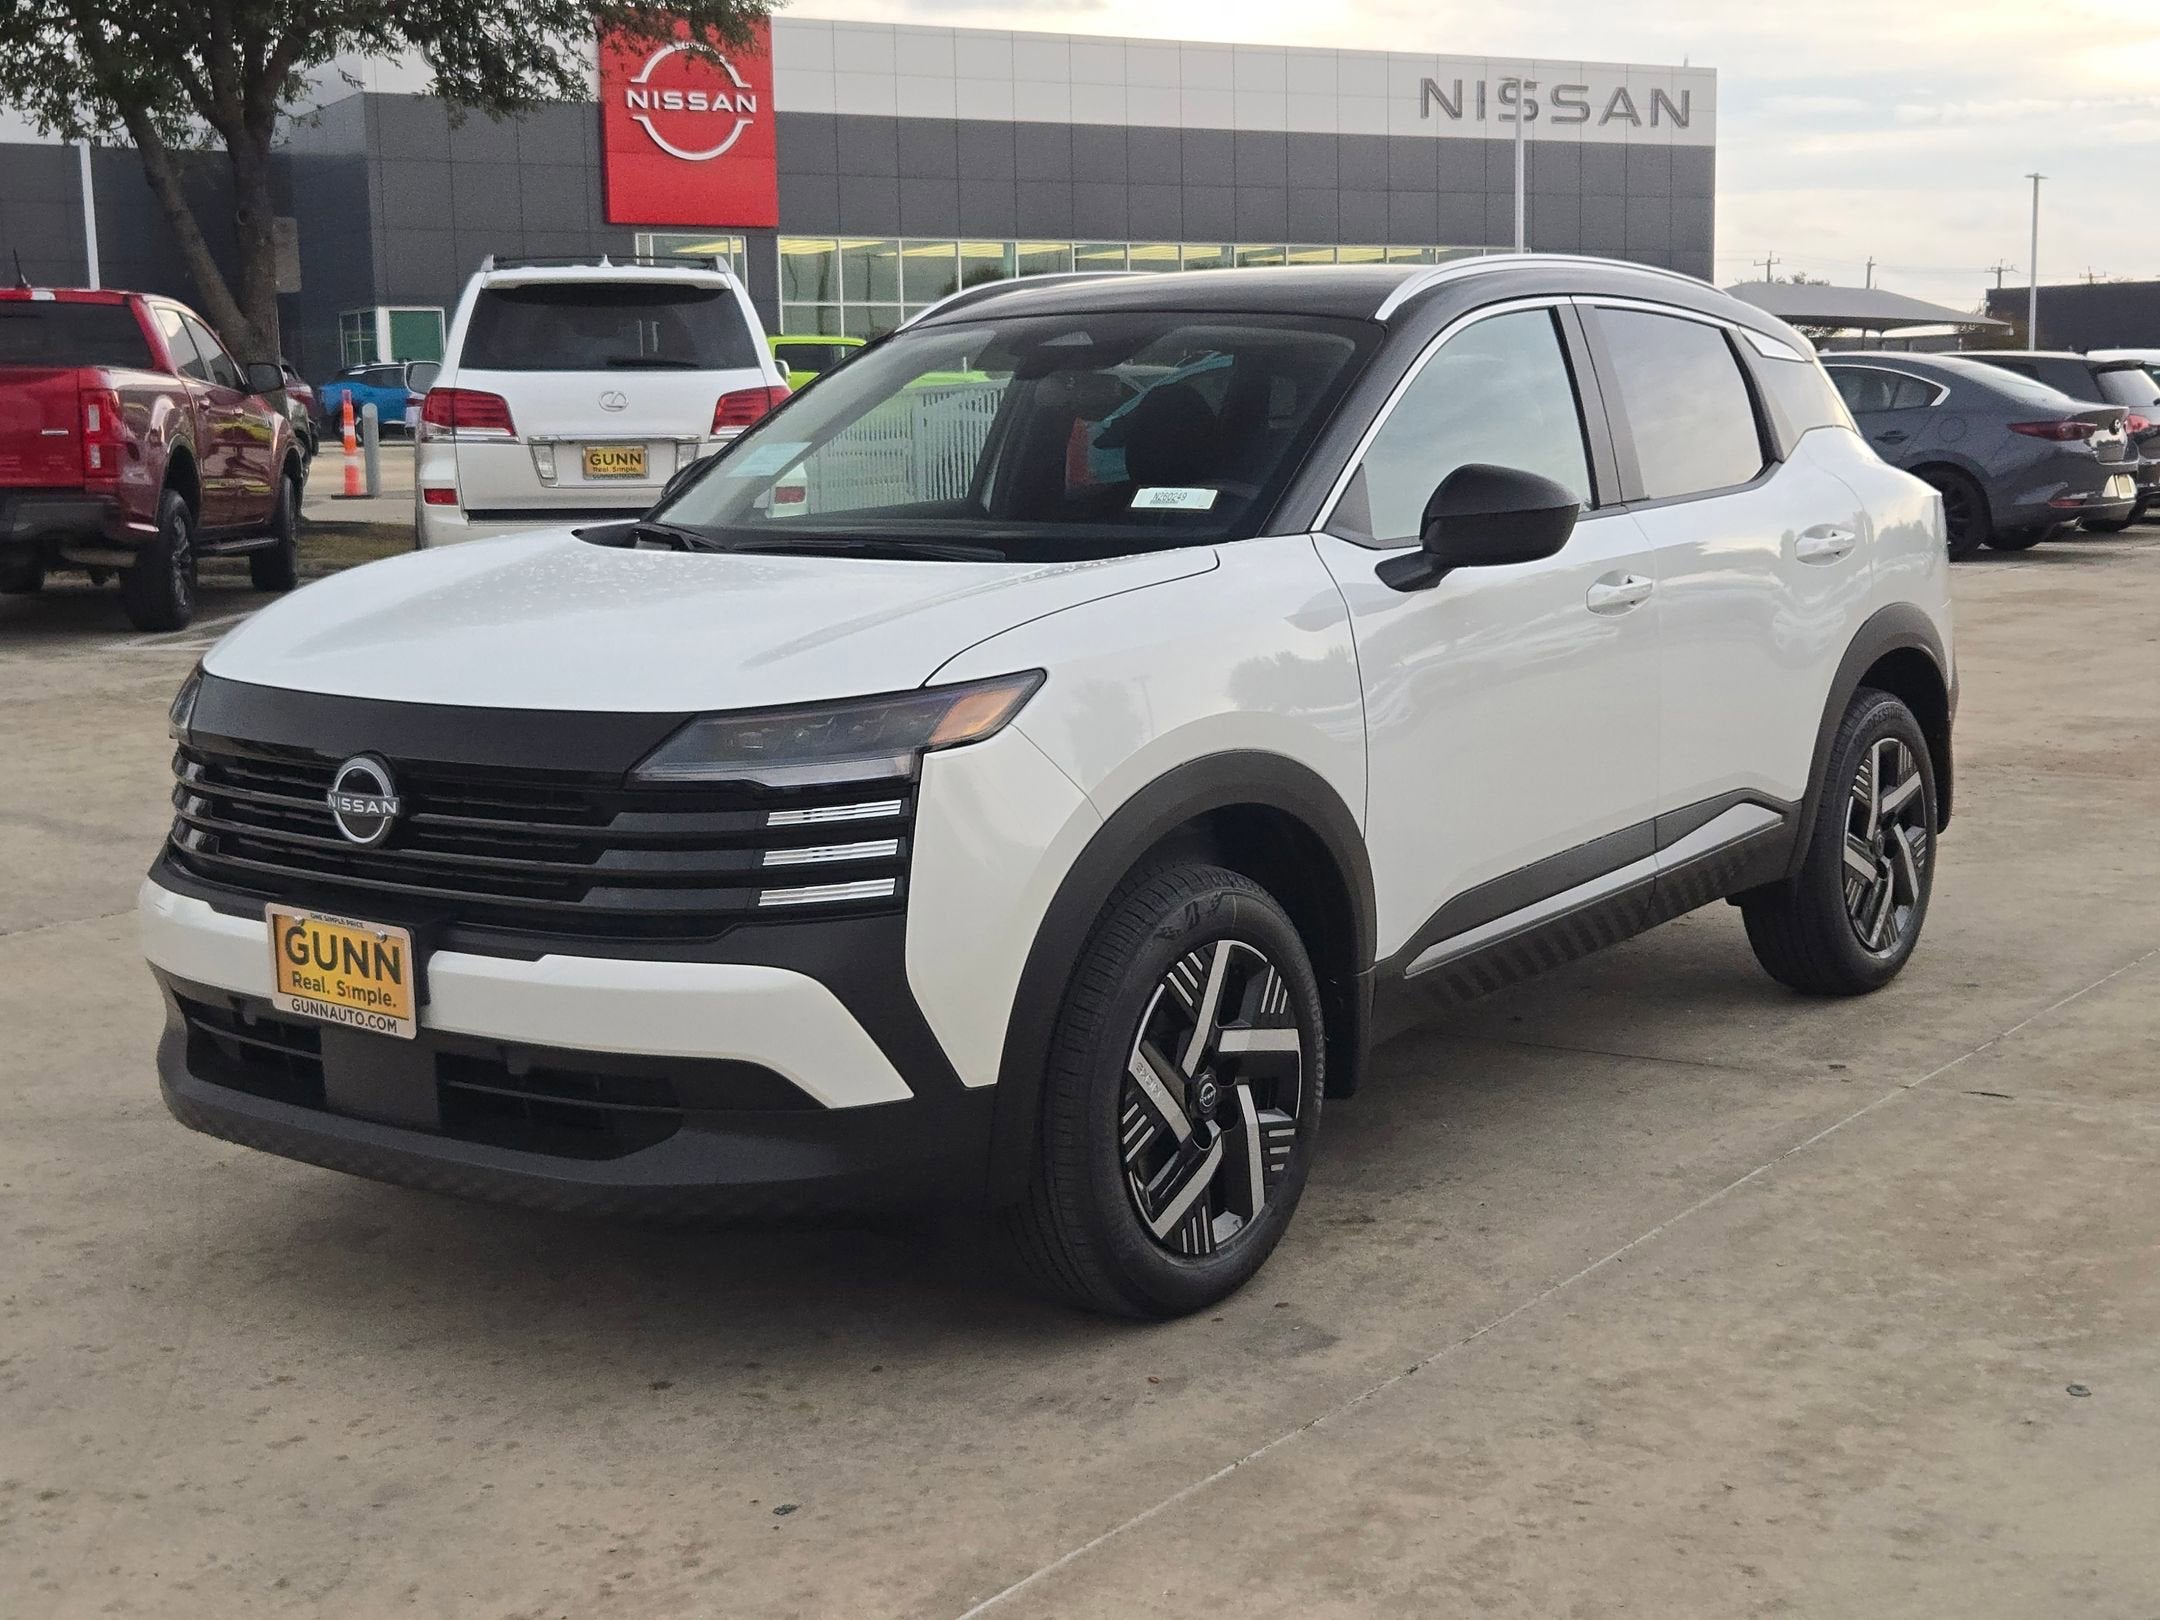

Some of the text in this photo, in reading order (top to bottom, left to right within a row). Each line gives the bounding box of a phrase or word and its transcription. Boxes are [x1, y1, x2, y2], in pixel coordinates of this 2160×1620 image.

[627, 89, 757, 113] NISSAN
[1420, 77, 1690, 128] NISSAN
[590, 453, 642, 466] GUNN
[327, 793, 397, 814] NISSAN
[285, 926, 402, 985] GUNN
[292, 970, 330, 995] Real.
[291, 998, 398, 1034] GUNNAUTO.COM
